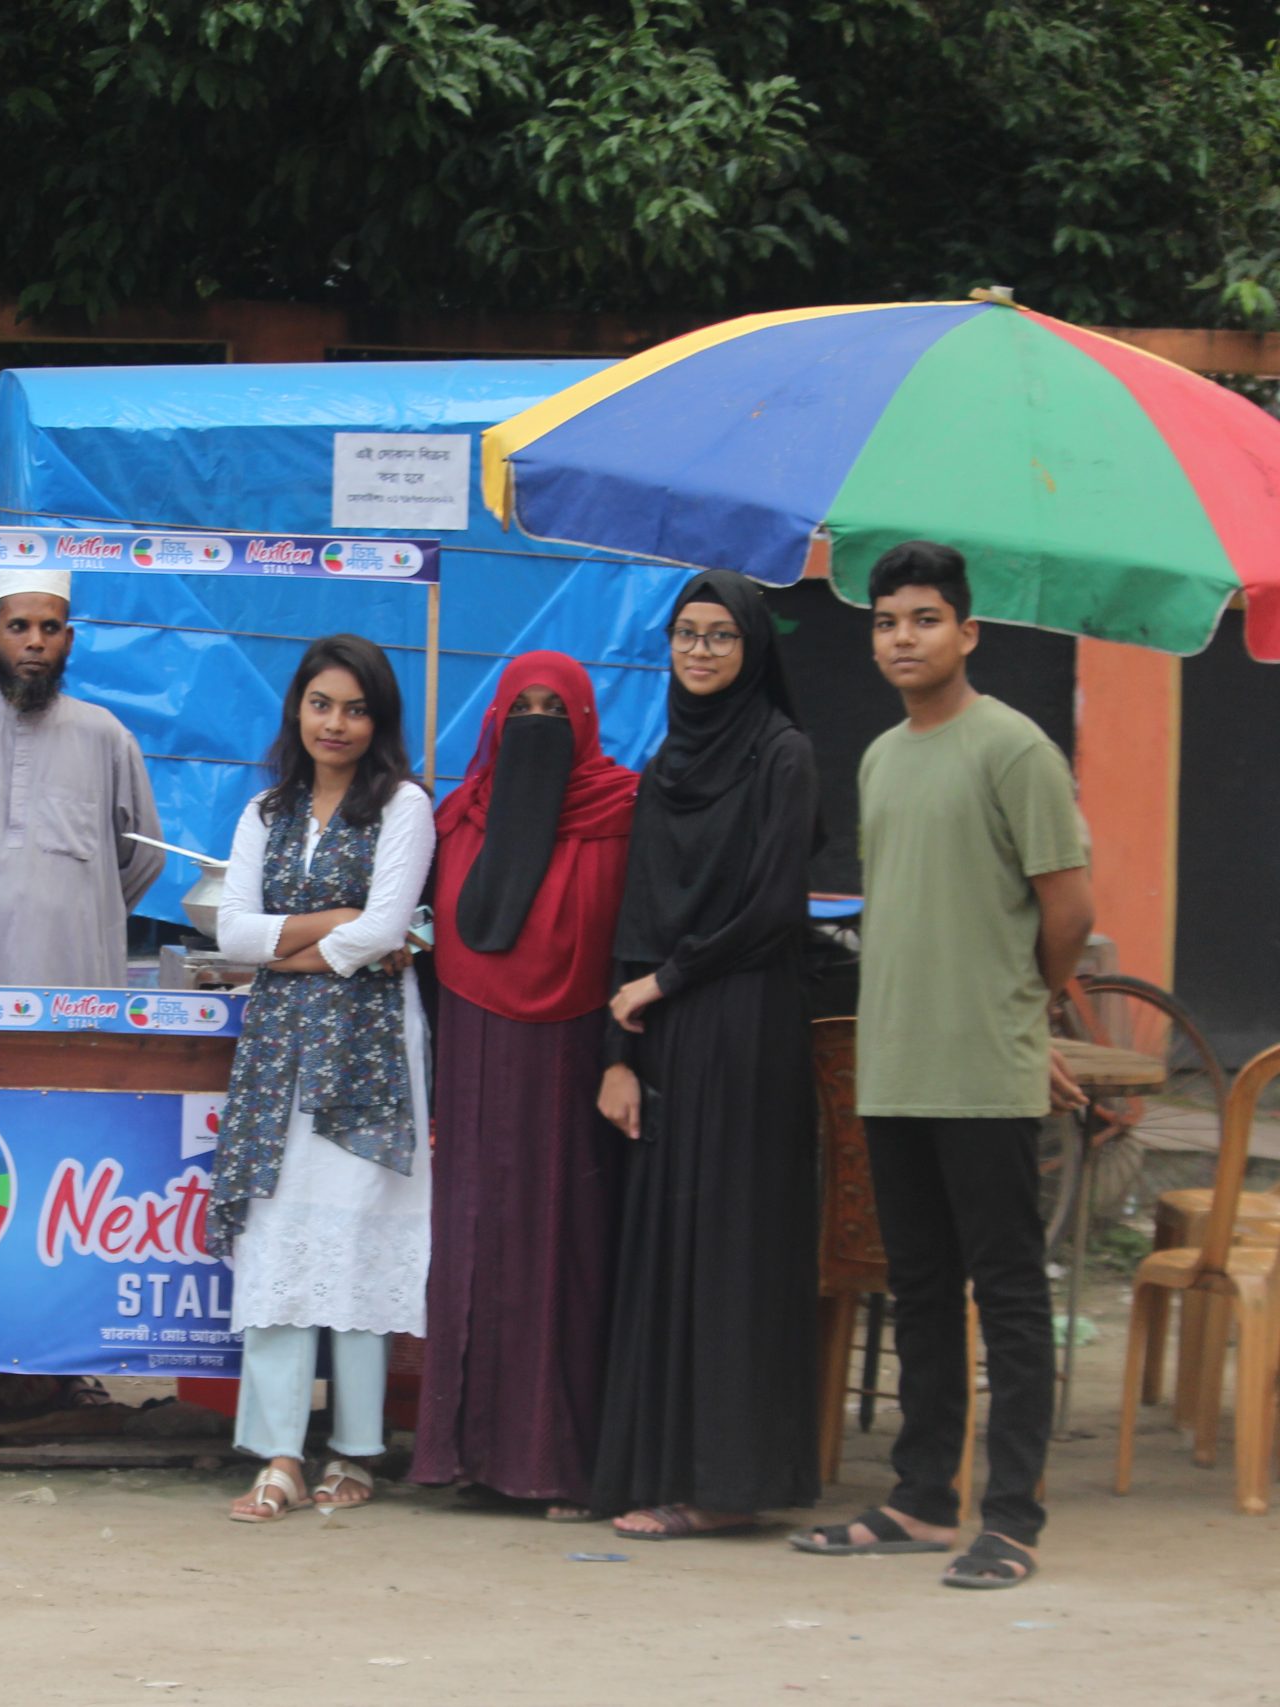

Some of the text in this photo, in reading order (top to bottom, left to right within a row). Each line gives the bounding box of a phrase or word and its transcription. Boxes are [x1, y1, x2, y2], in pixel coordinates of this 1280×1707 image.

[56, 535, 122, 559] NextGen
[246, 540, 313, 564] NextGen
[72, 560, 105, 569] STALL
[263, 565, 295, 574] STALL
[51, 994, 118, 1018] NextGen
[46, 1165, 210, 1259] Next
[118, 1273, 231, 1318] STAL
